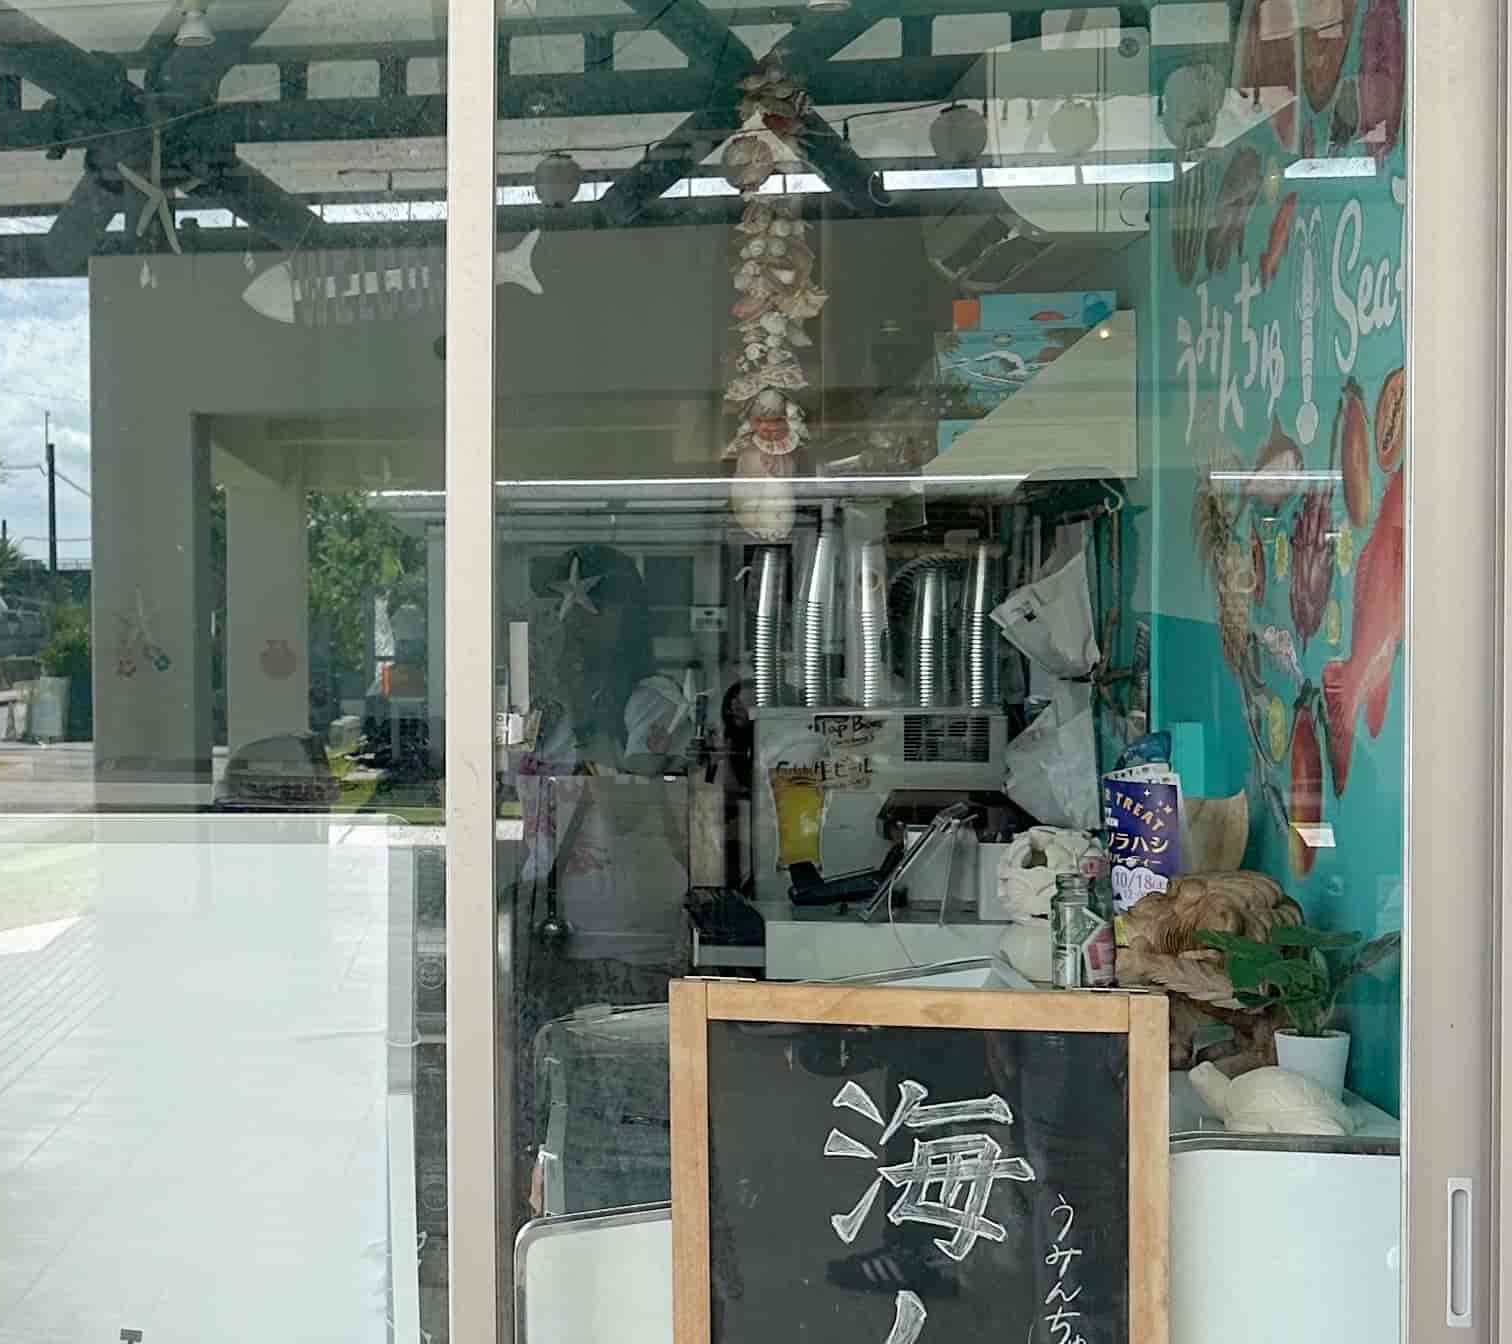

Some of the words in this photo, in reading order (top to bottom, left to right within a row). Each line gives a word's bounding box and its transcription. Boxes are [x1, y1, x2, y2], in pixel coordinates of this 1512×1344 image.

[1176, 261, 1286, 448] うみんちゅ
[1115, 791, 1165, 832] TREAT
